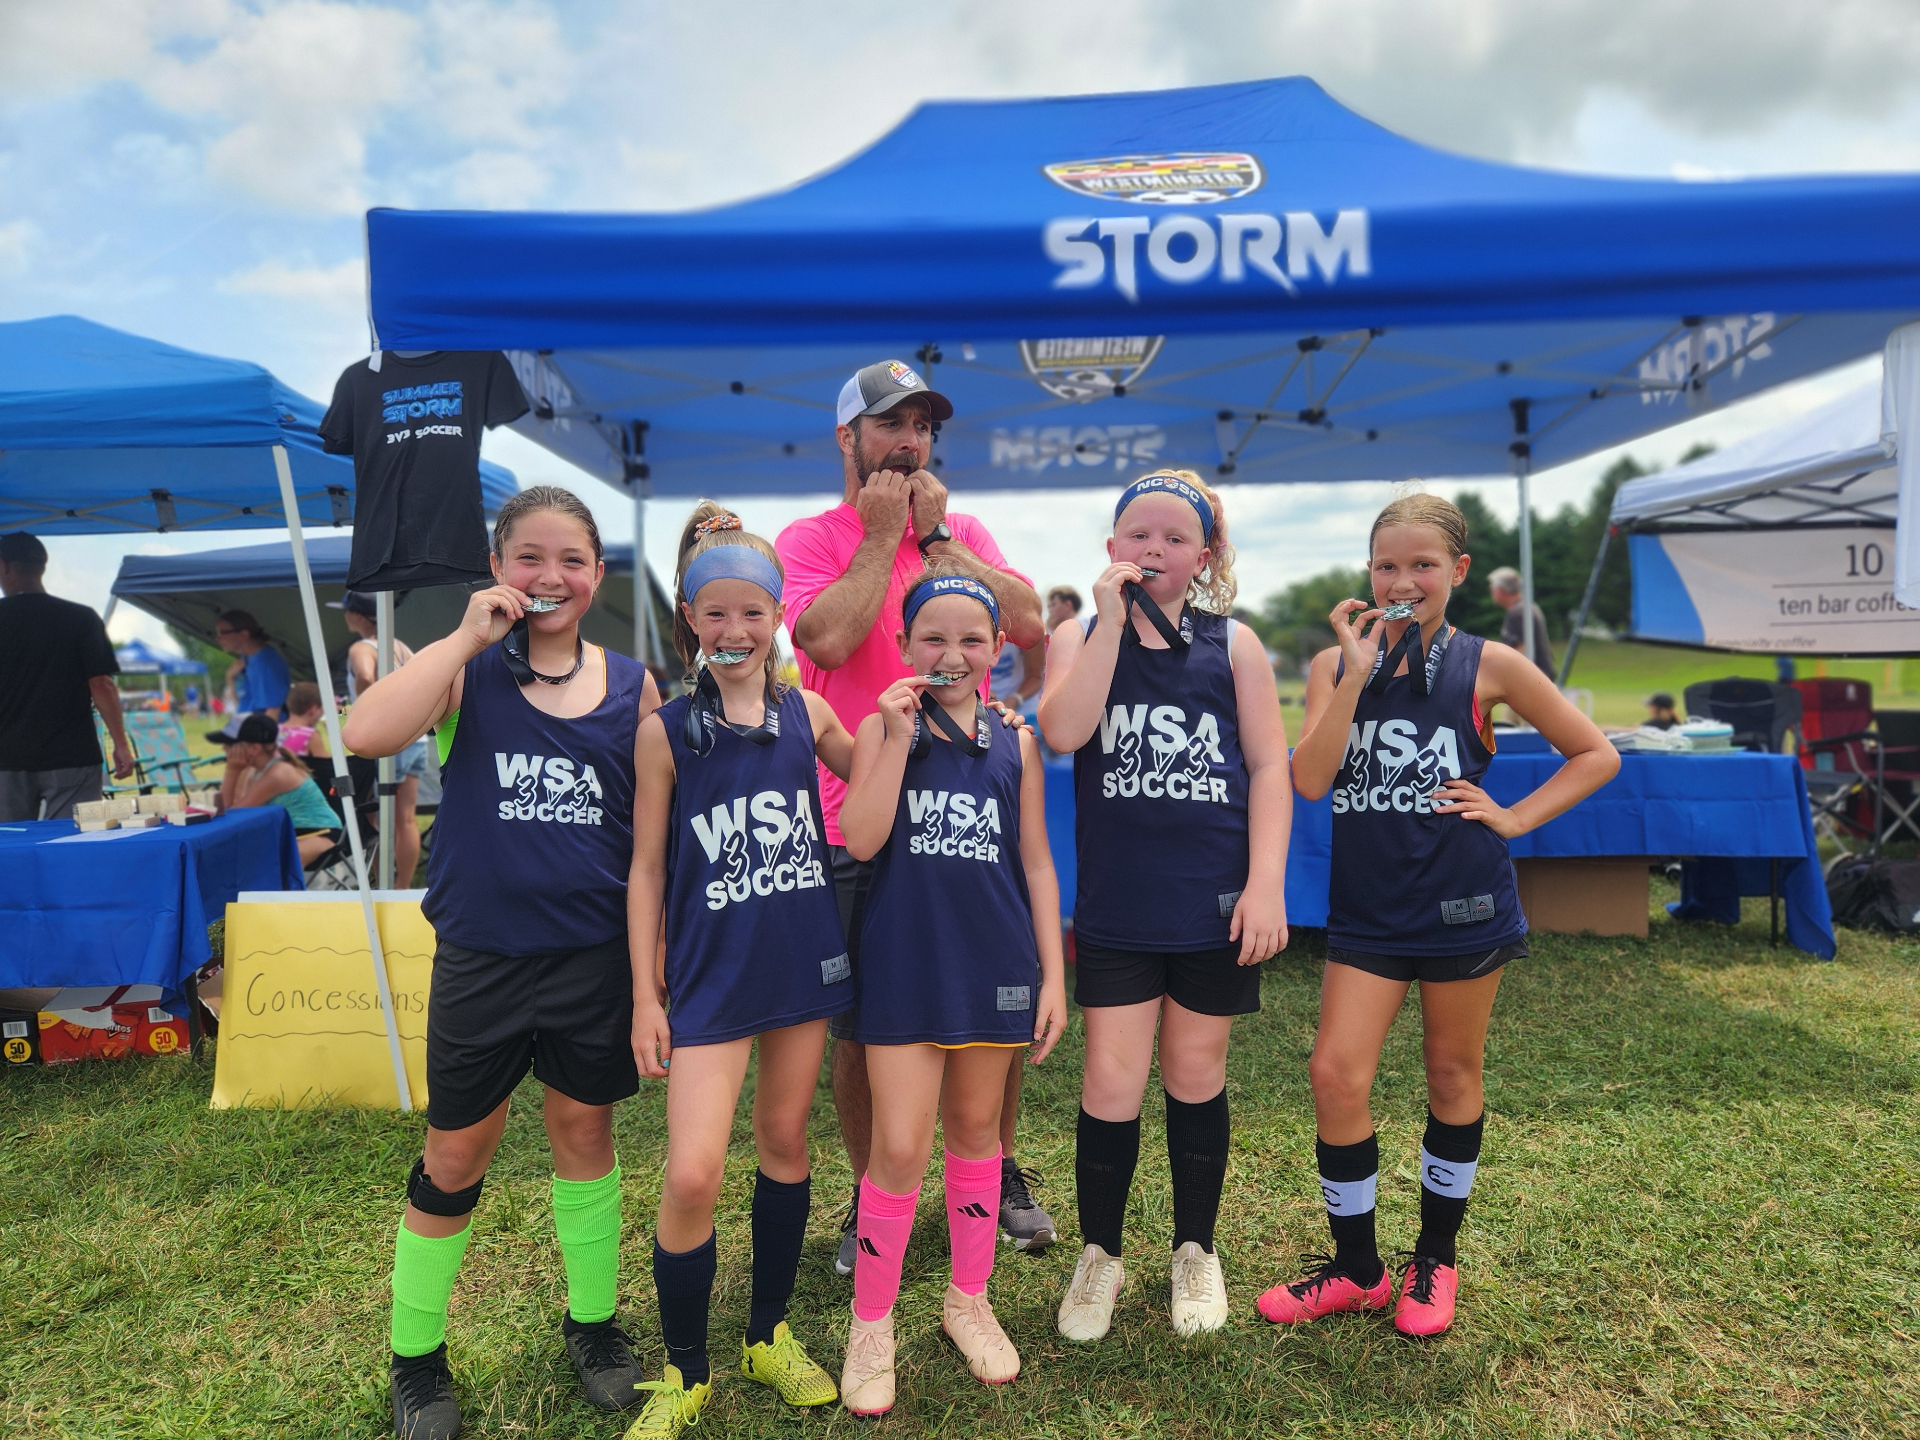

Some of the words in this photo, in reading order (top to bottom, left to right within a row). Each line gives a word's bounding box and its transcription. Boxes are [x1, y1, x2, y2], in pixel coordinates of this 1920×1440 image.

[1081, 172, 1243, 191] WESTMINSTER
[1043, 209, 1370, 302] STORM
[382, 381, 464, 405] SUMMER
[382, 398, 463, 424] STORM
[415, 425, 464, 439] SOCCER
[1846, 543, 1883, 577] 10
[1779, 597, 1812, 616] ten
[1818, 594, 1850, 614] bar
[1100, 704, 1225, 763] WSA
[495, 753, 603, 799] WSA
[1102, 772, 1230, 803] SOCCER
[498, 801, 603, 826] SOCCER
[907, 789, 1001, 834] WSA
[690, 789, 818, 864] WSA
[909, 835, 999, 863] SOCCER
[705, 860, 827, 911] SOCCER
[246, 973, 425, 1016] Concessins
[10, 1042, 25, 1055] 50
[154, 1031, 172, 1045] 50
